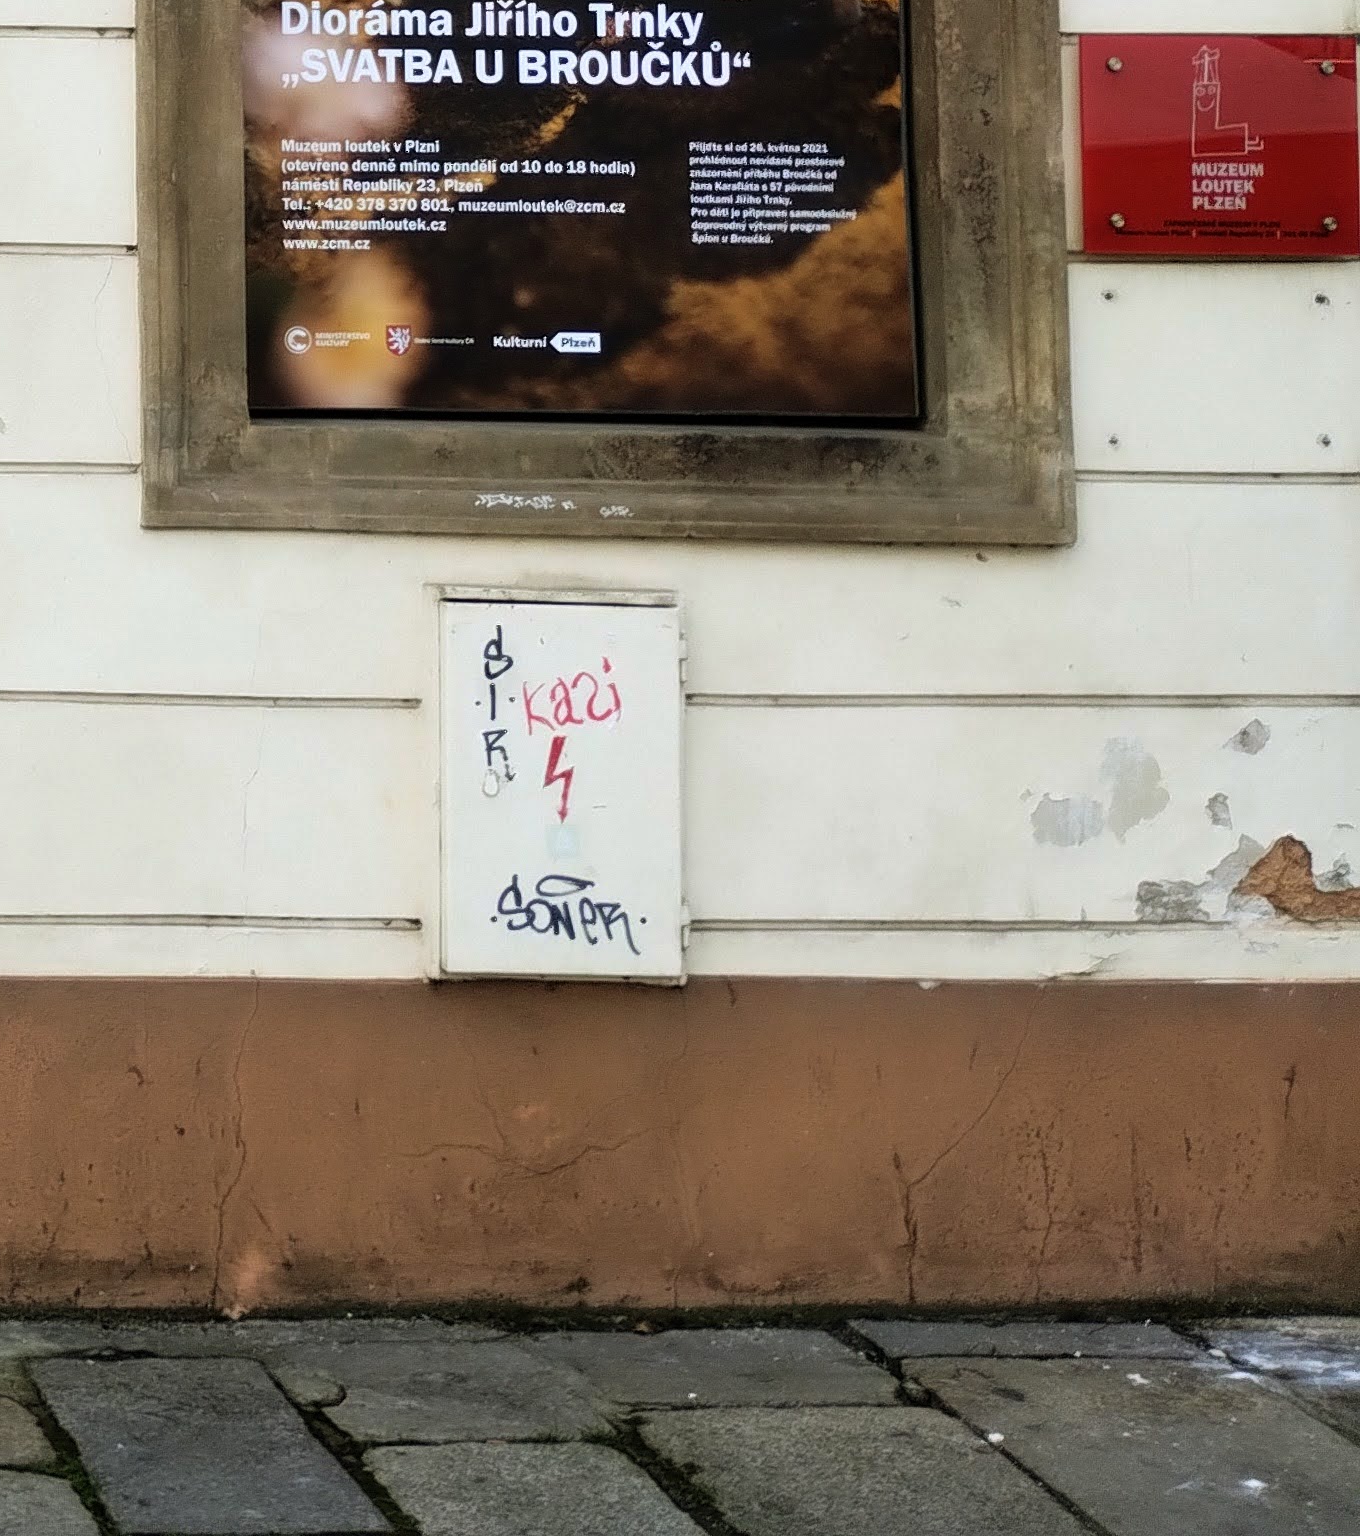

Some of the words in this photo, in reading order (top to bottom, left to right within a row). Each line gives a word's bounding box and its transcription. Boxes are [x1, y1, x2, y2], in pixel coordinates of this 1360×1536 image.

[281, 0, 452, 37] Dioráma
[465, 0, 578, 38] Jiřího
[589, 2, 703, 45] Trnky
[281, 49, 462, 88] „SVATBA
[475, 50, 503, 84] U
[518, 40, 752, 86] BROUČKŮ“
[281, 139, 341, 152] Muzeum
[345, 139, 390, 152] loutek
[394, 143, 401, 152] v
[405, 140, 440, 153] Plzni
[802, 143, 828, 154] 2021
[281, 158, 349, 173] (otevřeno
[352, 158, 396, 173] denně
[400, 160, 440, 173] mimo
[444, 158, 497, 175] pondělí
[500, 160, 518, 173] od
[521, 160, 540, 173] 10
[544, 160, 563, 174] do
[566, 161, 586, 174] 18
[590, 161, 636, 177] hodin)
[1191, 162, 1264, 177] MUZEUM
[282, 178, 340, 192] náměstí
[343, 178, 413, 194] Republiky
[416, 179, 440, 193] 23,
[444, 178, 483, 192] Plzeň
[1192, 179, 1255, 194] LOUTEK
[315, 198, 353, 211] +420
[356, 198, 385, 211] 378
[388, 198, 417, 211] 370
[421, 199, 454, 213] 801,
[458, 199, 626, 214] muzeumloutek@zcm.cz
[1193, 193, 1246, 210] PLZEŇ
[283, 218, 447, 231] www.muzeumloutek.cz
[283, 238, 370, 250] www.zcm.cz
[561, 337, 596, 348] Plzeň
